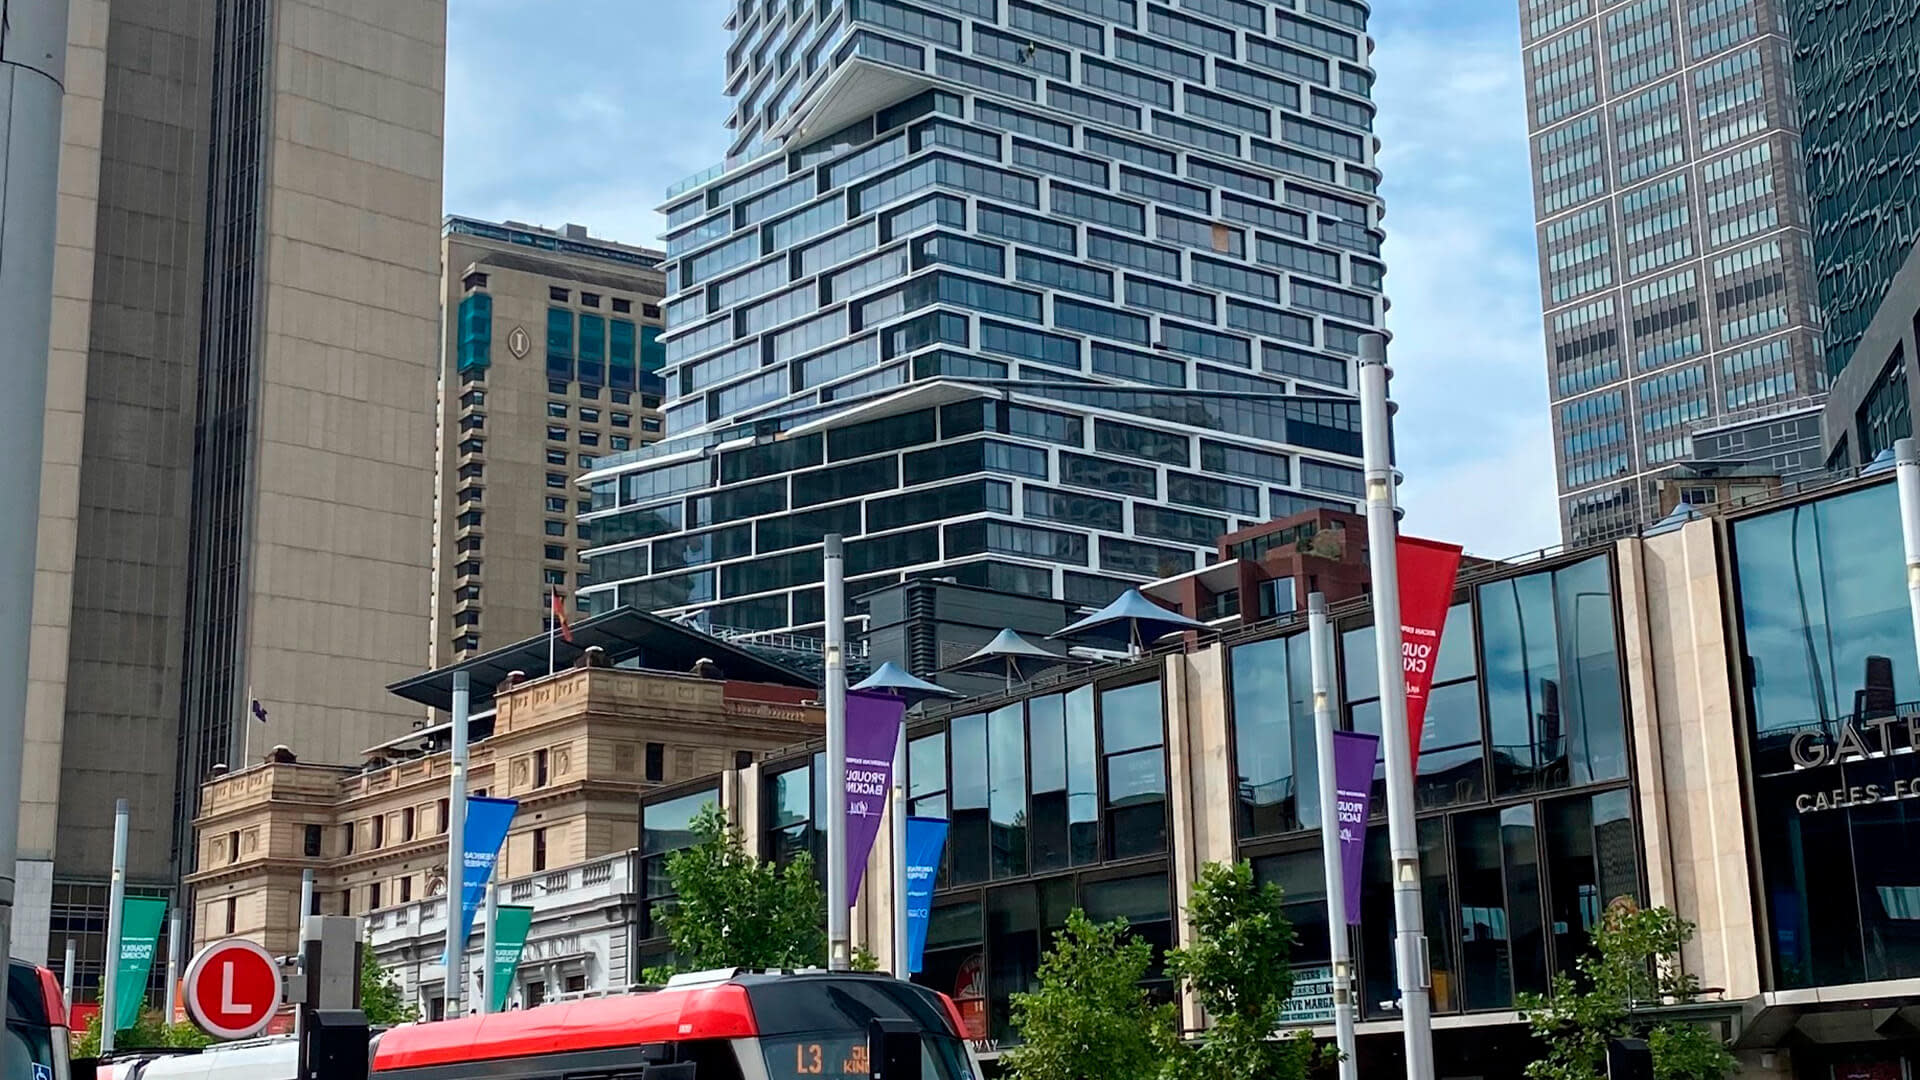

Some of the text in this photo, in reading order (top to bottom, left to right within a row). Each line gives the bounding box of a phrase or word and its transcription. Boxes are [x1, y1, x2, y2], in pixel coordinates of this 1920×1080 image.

[1796, 784, 1880, 813] CAFES
[221, 961, 252, 1014] L
[797, 1044, 822, 1074] L3
